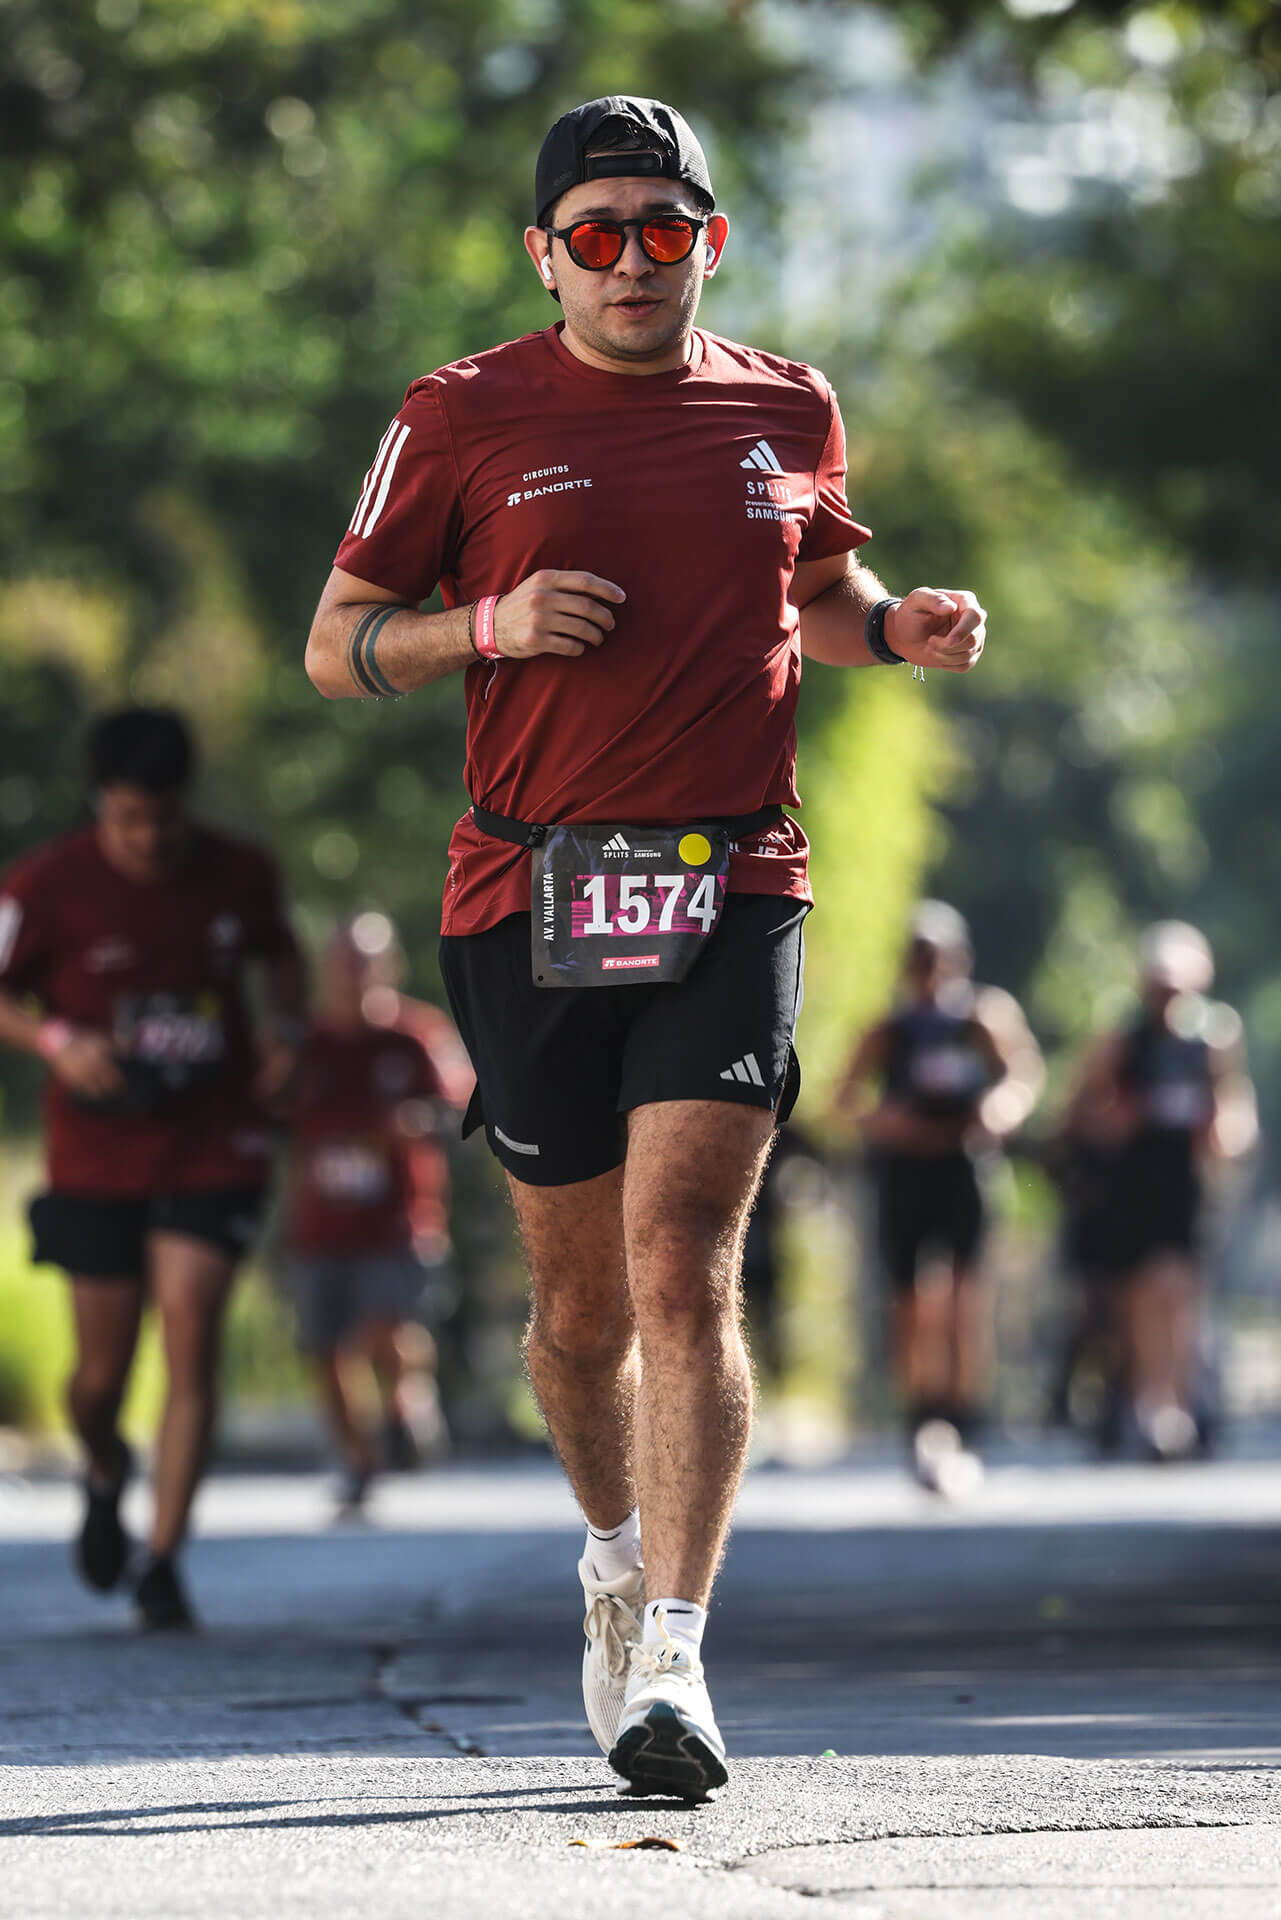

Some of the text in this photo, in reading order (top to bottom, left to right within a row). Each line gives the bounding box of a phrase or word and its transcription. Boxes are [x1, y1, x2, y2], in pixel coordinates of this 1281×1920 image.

[522, 464, 569, 482] CIRCUITOS
[523, 479, 593, 501] BANORTE
[543, 872, 554, 941] AV. VALLARTA
[583, 874, 717, 934] 1574
[615, 958, 657, 966] BANORTE
